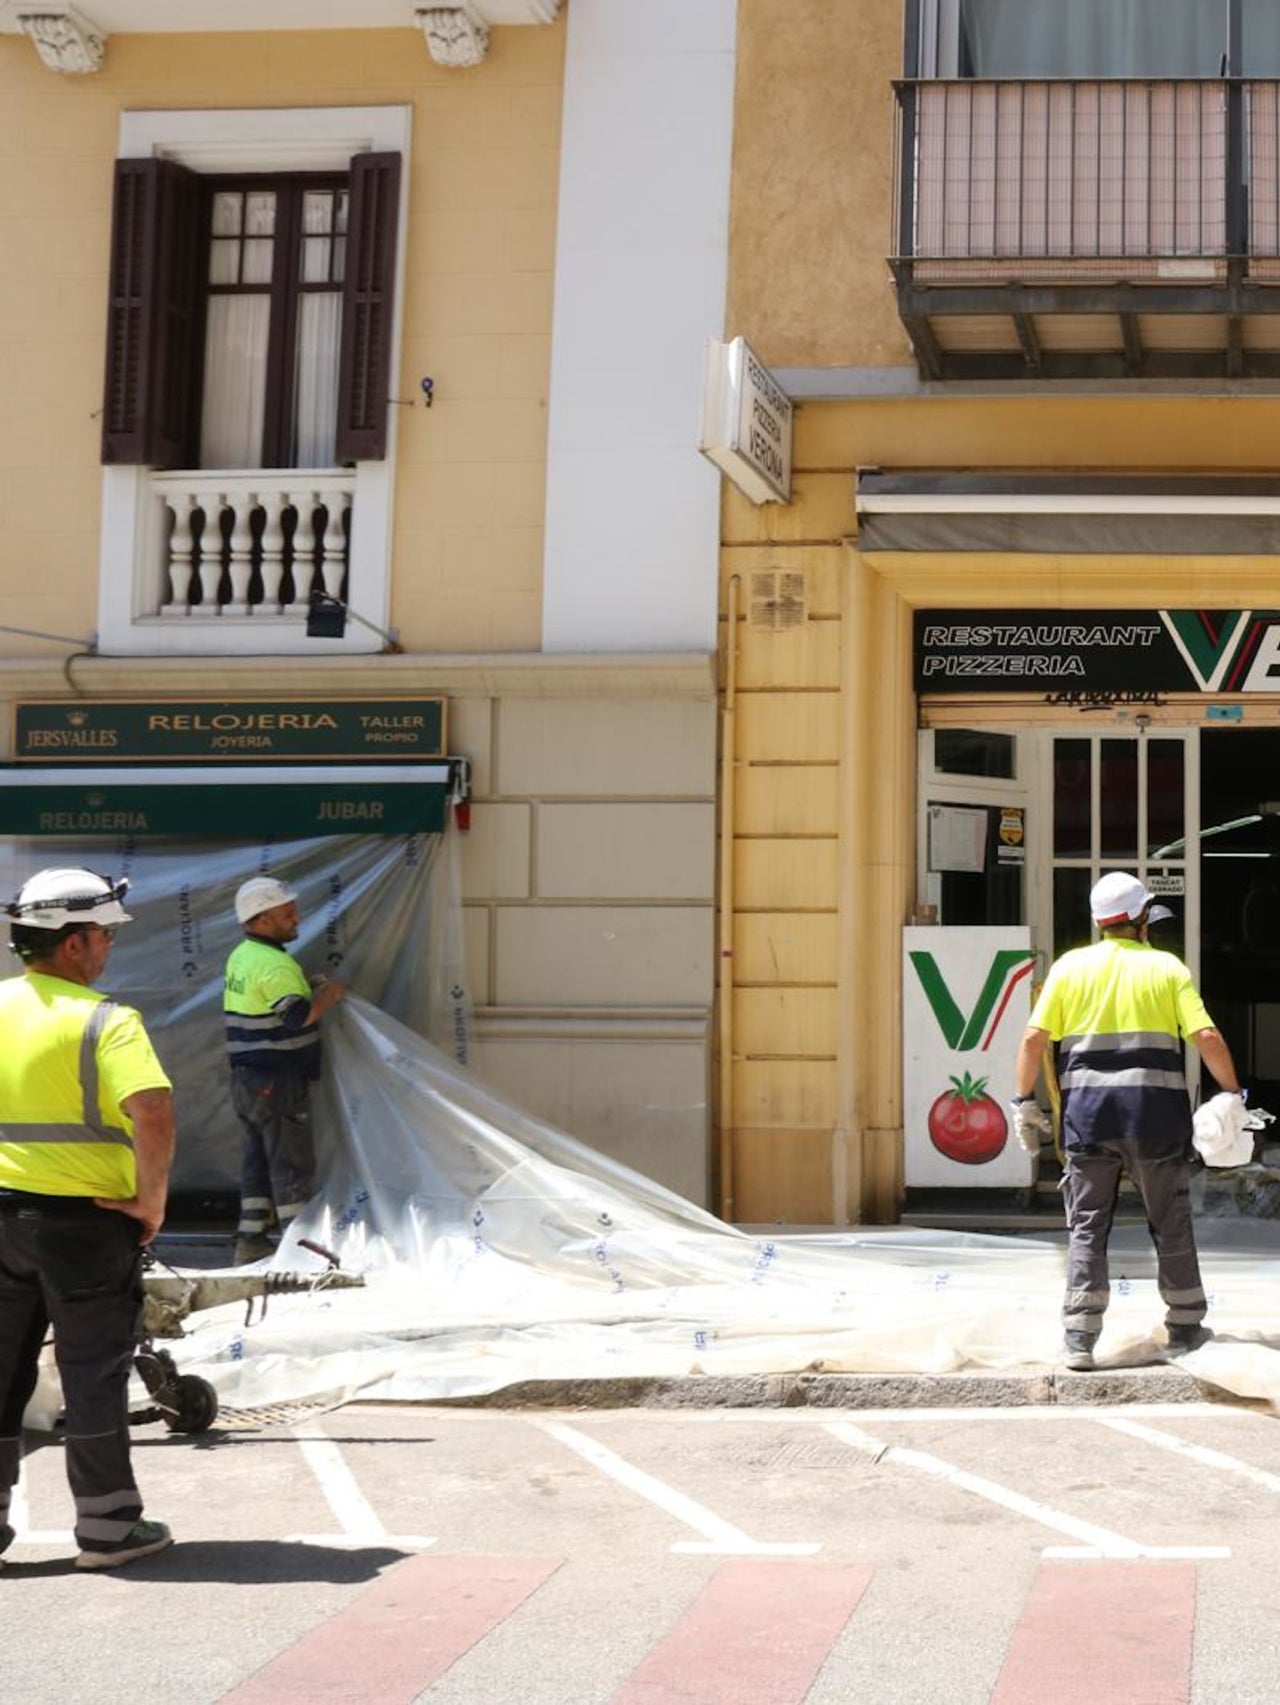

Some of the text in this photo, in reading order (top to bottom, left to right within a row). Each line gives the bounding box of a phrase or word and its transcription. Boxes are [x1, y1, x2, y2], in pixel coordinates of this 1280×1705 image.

[748, 355, 790, 423] RESTAURANT
[754, 397, 781, 446] PIZZERIA
[750, 424, 783, 485] VERONA
[922, 626, 1160, 645] RESTAURANT
[922, 655, 1086, 676] PIZZERIA
[148, 713, 338, 730] RELOJERIA
[360, 715, 426, 728] TALLER
[26, 730, 118, 749] JERSVALLES
[210, 735, 272, 749] JOYERIA
[364, 732, 419, 743] PROPIO
[317, 801, 384, 820] JUBAR
[40, 811, 148, 830] RELOJERIA
